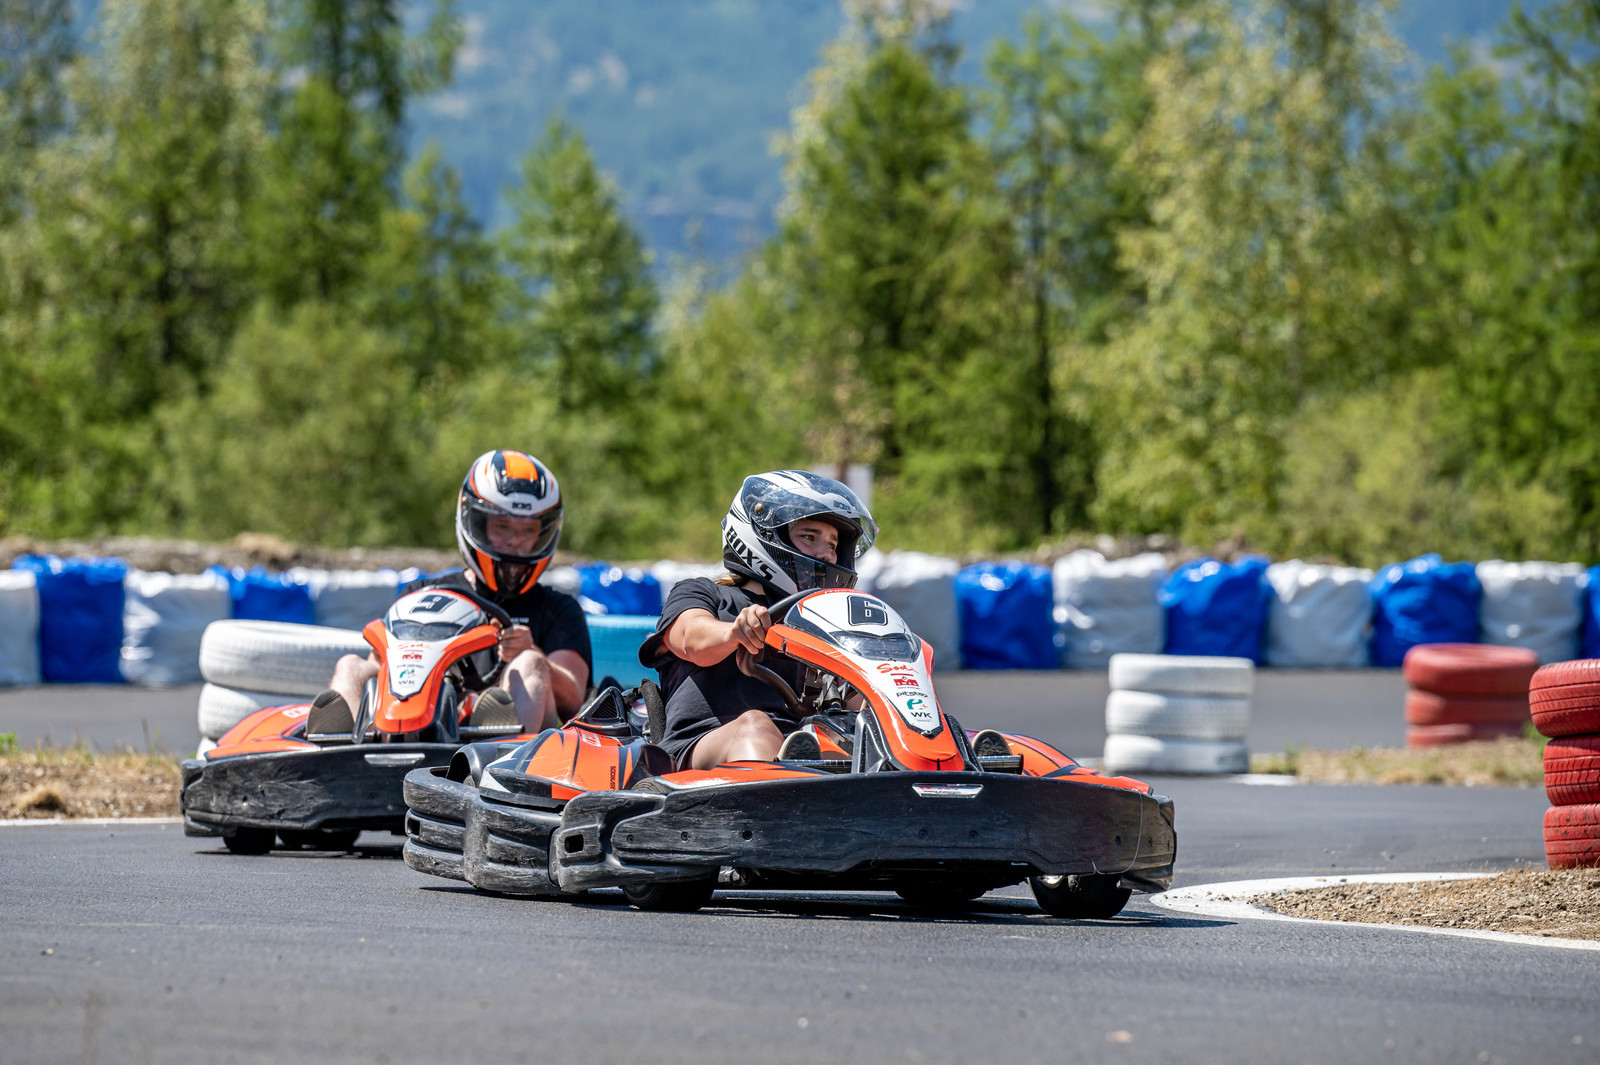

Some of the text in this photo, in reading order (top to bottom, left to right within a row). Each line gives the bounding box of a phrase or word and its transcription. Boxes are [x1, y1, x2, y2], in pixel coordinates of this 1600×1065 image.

[726, 525, 777, 580] BOX'S
[409, 594, 458, 614] 9
[847, 595, 888, 626] 6
